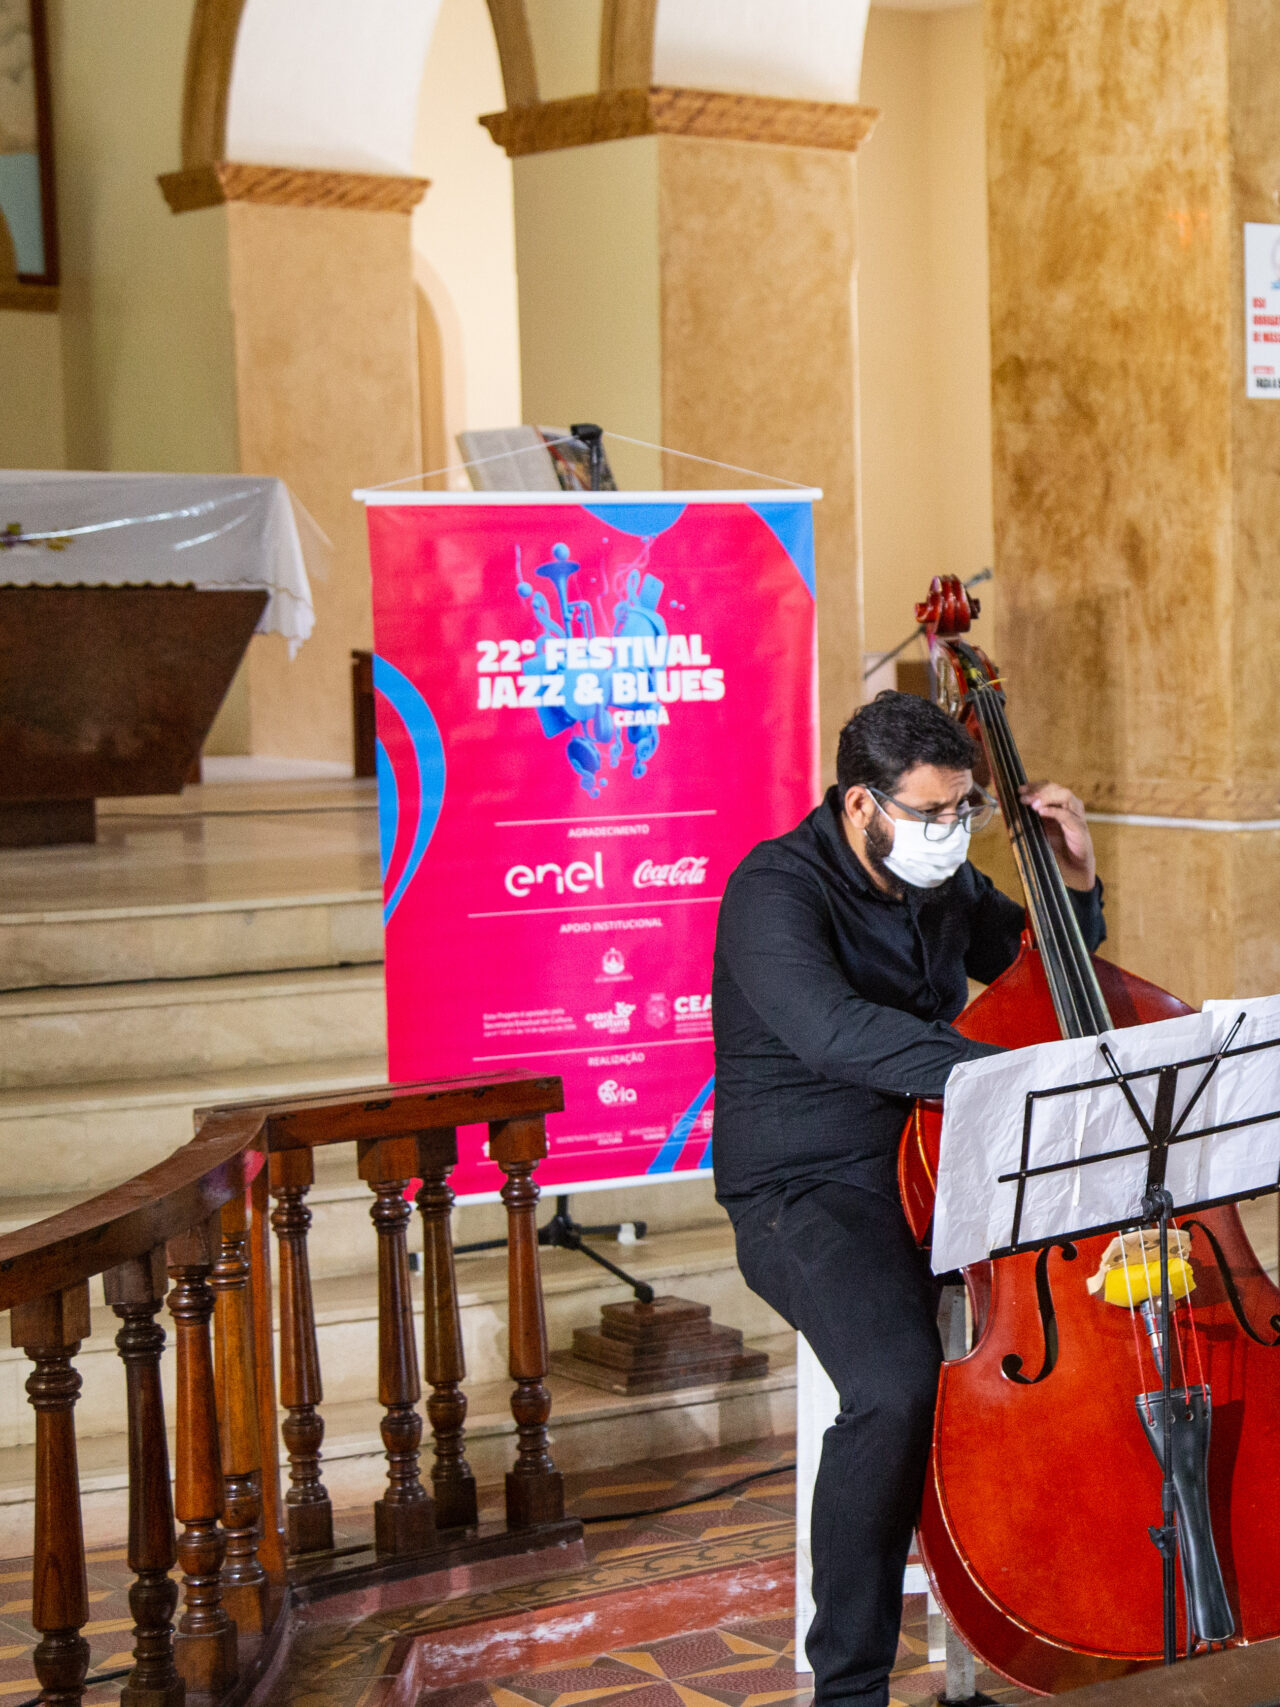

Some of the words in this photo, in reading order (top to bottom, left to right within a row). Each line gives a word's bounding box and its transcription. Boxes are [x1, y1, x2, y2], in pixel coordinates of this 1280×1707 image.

[545, 634, 711, 670] FESTIVAL
[477, 674, 566, 710] JAZZ
[573, 672, 604, 705] &
[612, 668, 726, 704] BLUES
[568, 824, 650, 838] AGRADECIMENTO
[504, 851, 605, 898] enel
[559, 920, 592, 934] APOIO
[593, 917, 663, 932] INSTITUCIONAL
[588, 1051, 645, 1067] REALIZAÇÃO
